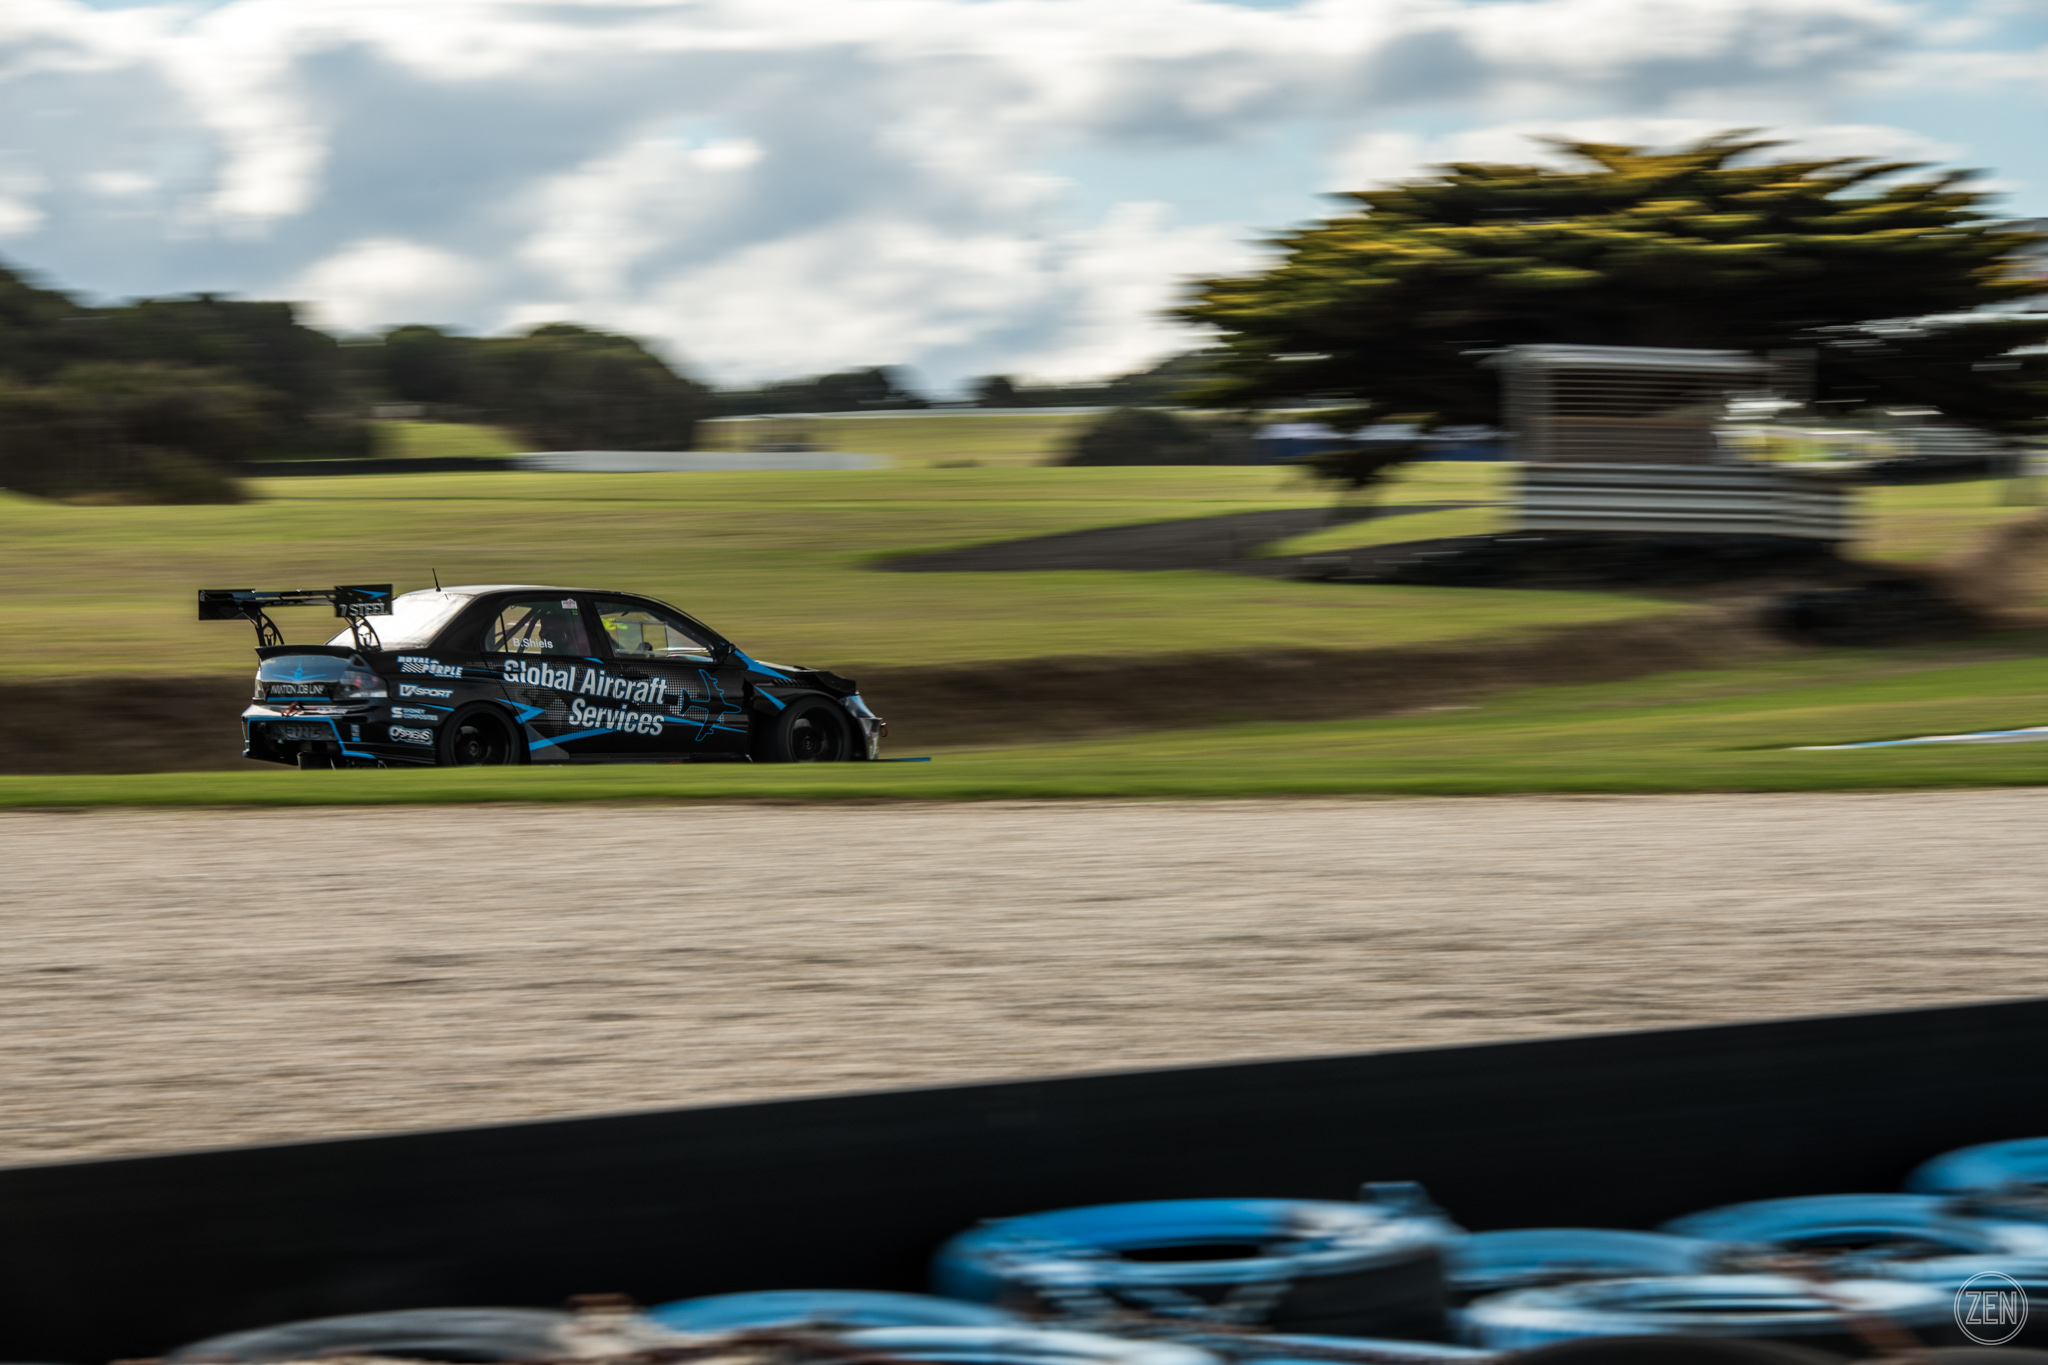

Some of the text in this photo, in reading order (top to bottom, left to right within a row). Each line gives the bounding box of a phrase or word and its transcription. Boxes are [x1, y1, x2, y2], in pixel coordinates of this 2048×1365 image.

[512, 637, 553, 649] B.Shiels
[397, 656, 430, 664] ROYAL
[421, 664, 463, 676] PURPLE
[503, 659, 668, 705] Global Aircraft
[568, 697, 665, 736] Services
